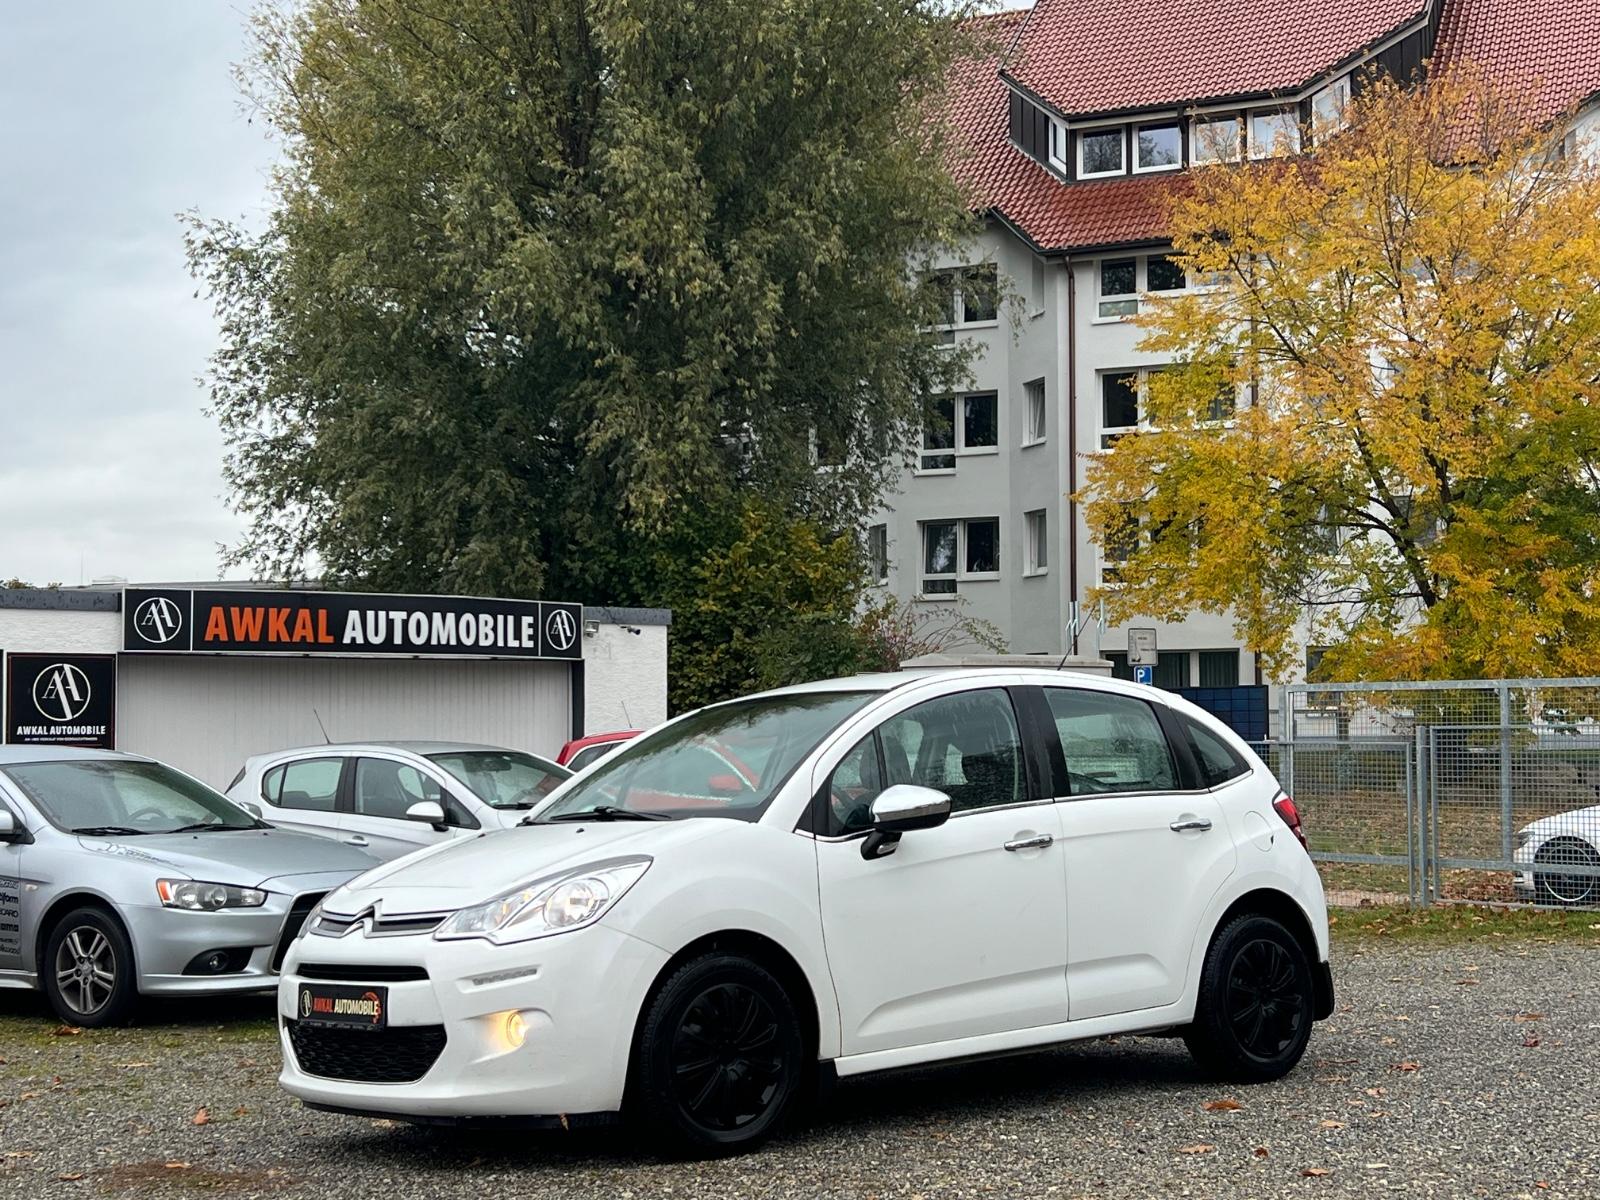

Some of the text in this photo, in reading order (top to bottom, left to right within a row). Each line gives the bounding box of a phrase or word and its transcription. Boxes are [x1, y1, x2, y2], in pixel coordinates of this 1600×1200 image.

[203, 606, 535, 648] AWKAL AUTOMOBILE
[1137, 669, 1145, 683] P
[16, 726, 106, 735] AWKAL AUTOMOBILE
[334, 999, 380, 1015] AUTOMOBILE
